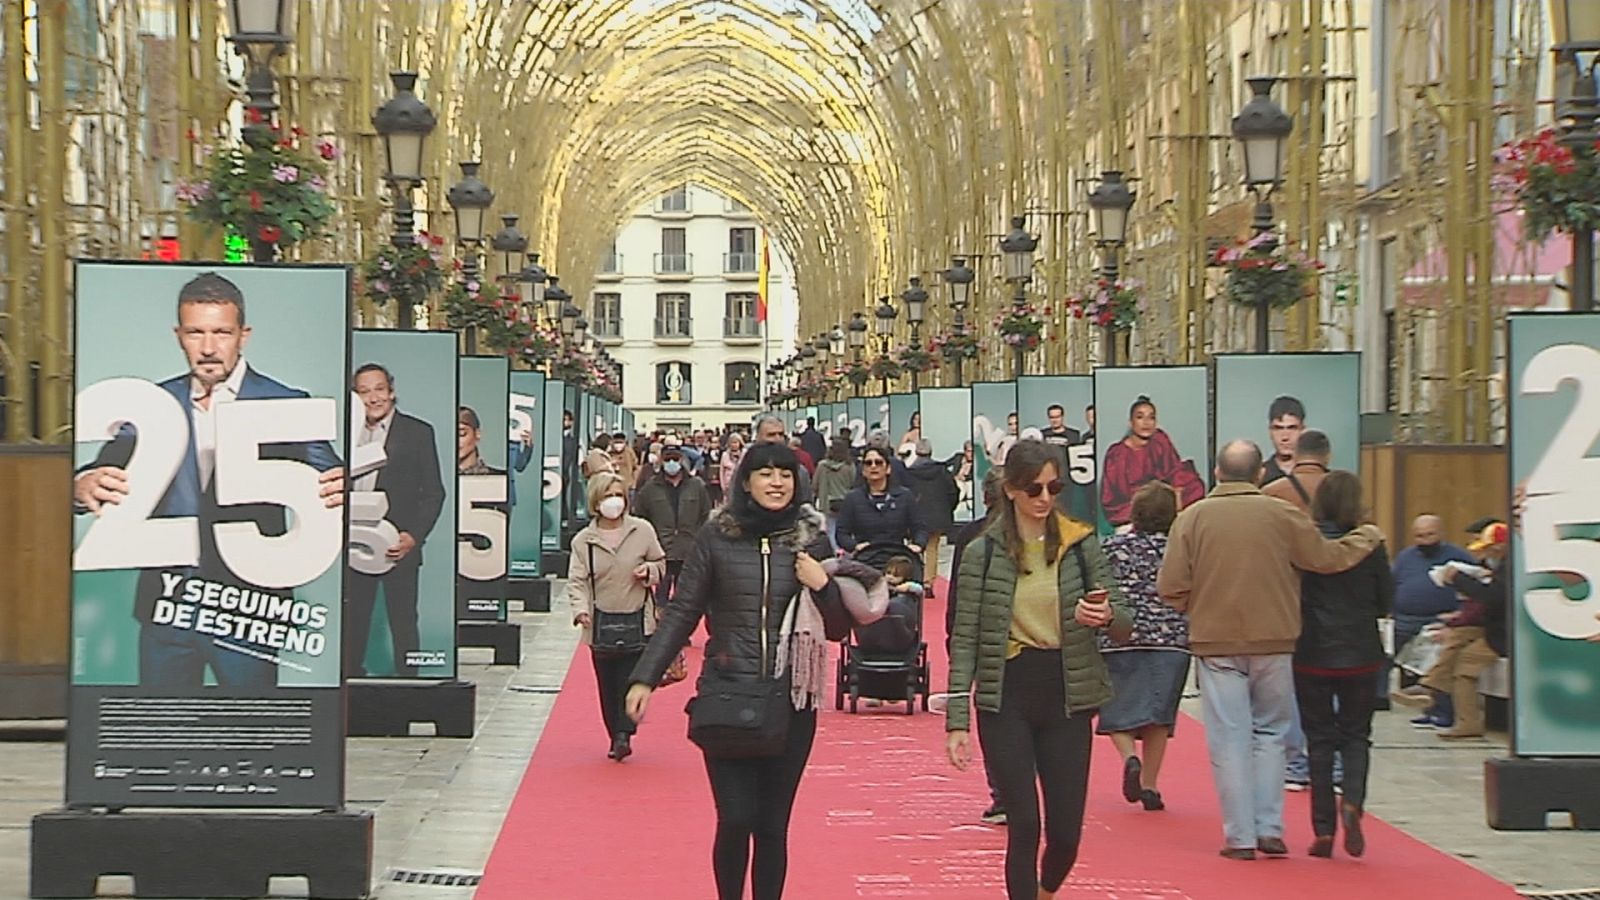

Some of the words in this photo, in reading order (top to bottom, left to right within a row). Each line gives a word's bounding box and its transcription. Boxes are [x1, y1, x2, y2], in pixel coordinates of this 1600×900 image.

[74, 376, 344, 589] 25
[1067, 438, 1095, 485] 5
[459, 474, 508, 581] 5
[152, 598, 196, 629] DE
[194, 607, 326, 657] ESTRENO
[160, 572, 183, 598] Y
[181, 578, 329, 630] SEGUIMOS
